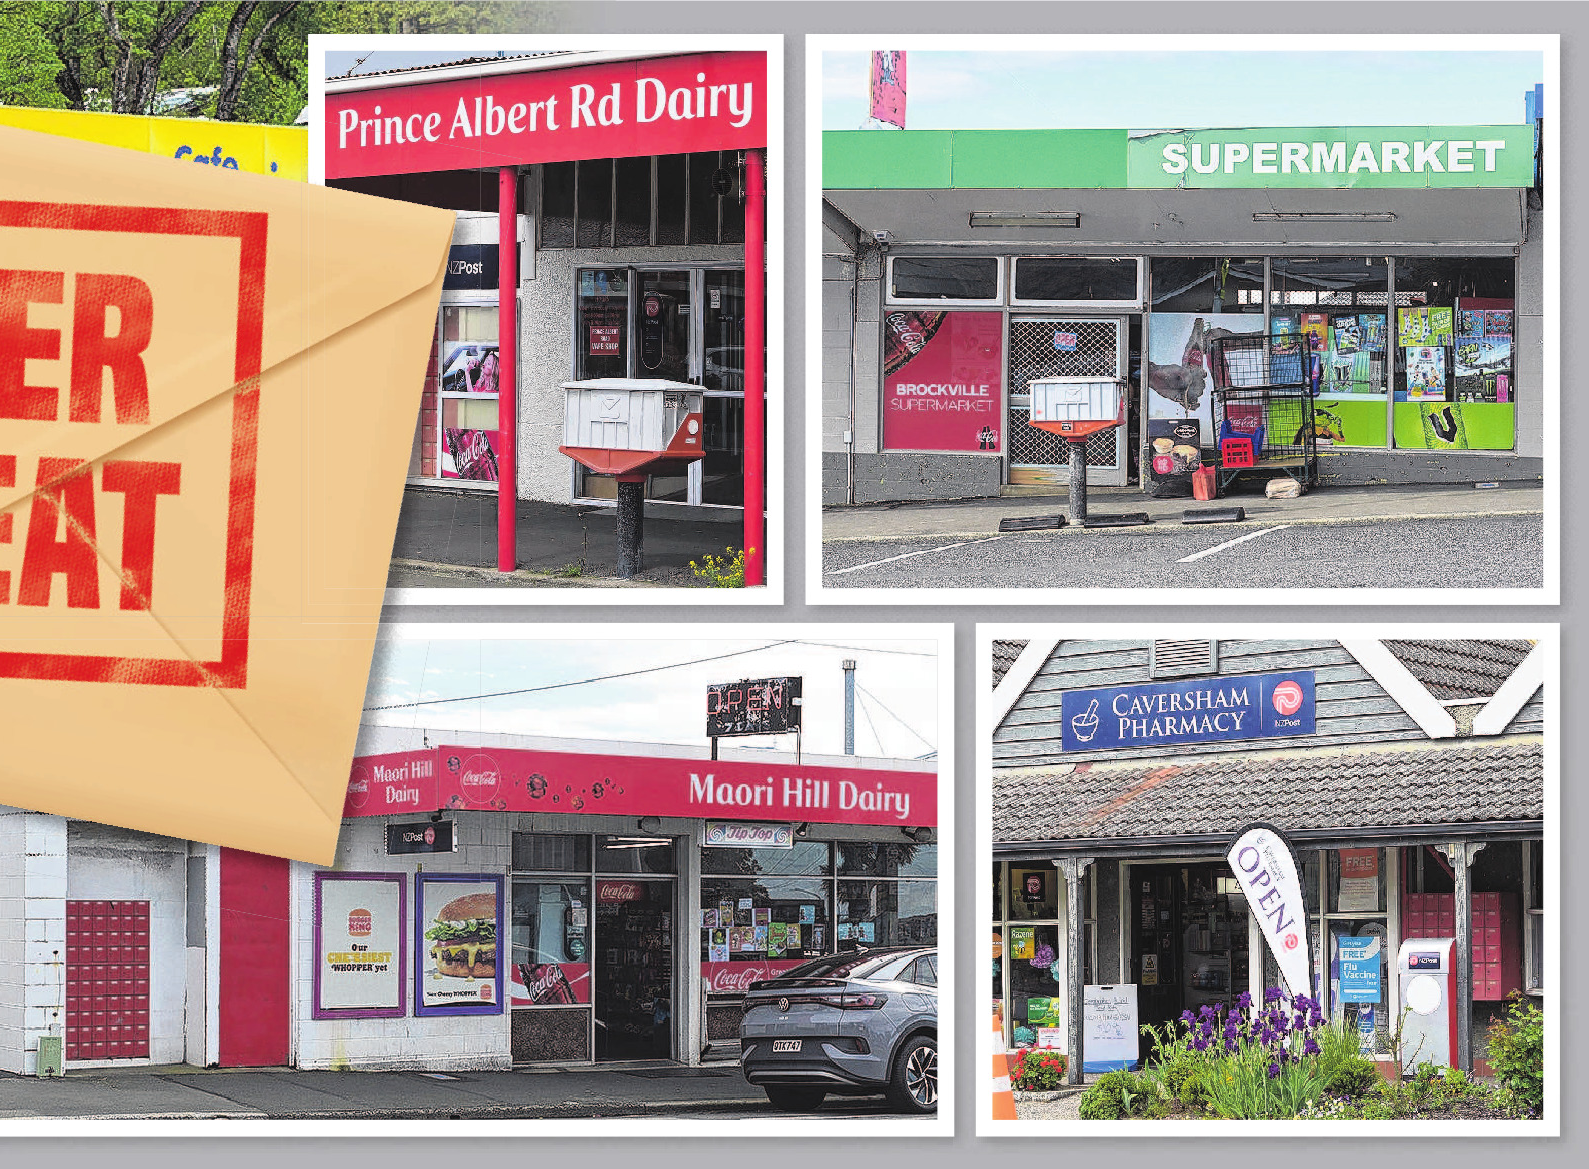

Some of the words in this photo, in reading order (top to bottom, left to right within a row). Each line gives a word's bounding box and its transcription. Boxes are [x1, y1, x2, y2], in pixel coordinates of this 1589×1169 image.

[337, 105, 442, 150] Prince
[448, 95, 559, 139] Albert
[569, 82, 624, 129] Rd
[635, 72, 754, 129] Dairy
[1161, 138, 1506, 175] SUPERMARKET
[605, 342, 619, 350] SHOP
[896, 383, 990, 397] BROCKVILLE
[890, 397, 995, 412] SUPERMARKET
[706, 685, 784, 714] OPEN
[1112, 686, 1251, 716] CAVERSHAM
[1117, 711, 1246, 740] PHARMACY
[1274, 719, 1301, 728] NZPost
[373, 762, 409, 784] Maori
[411, 759, 433, 779] Hill
[385, 785, 420, 806] Dairy
[688, 773, 774, 806] Maori
[782, 777, 831, 810] Hill
[838, 780, 911, 819] Dairy
[726, 825, 749, 840] Tip
[748, 826, 774, 841] Top
[1237, 846, 1296, 935] OPEN
[351, 943, 368, 952] Our
[374, 963, 388, 973] yet
[1343, 962, 1358, 971] Flu
[1343, 970, 1377, 979] Vaccine
